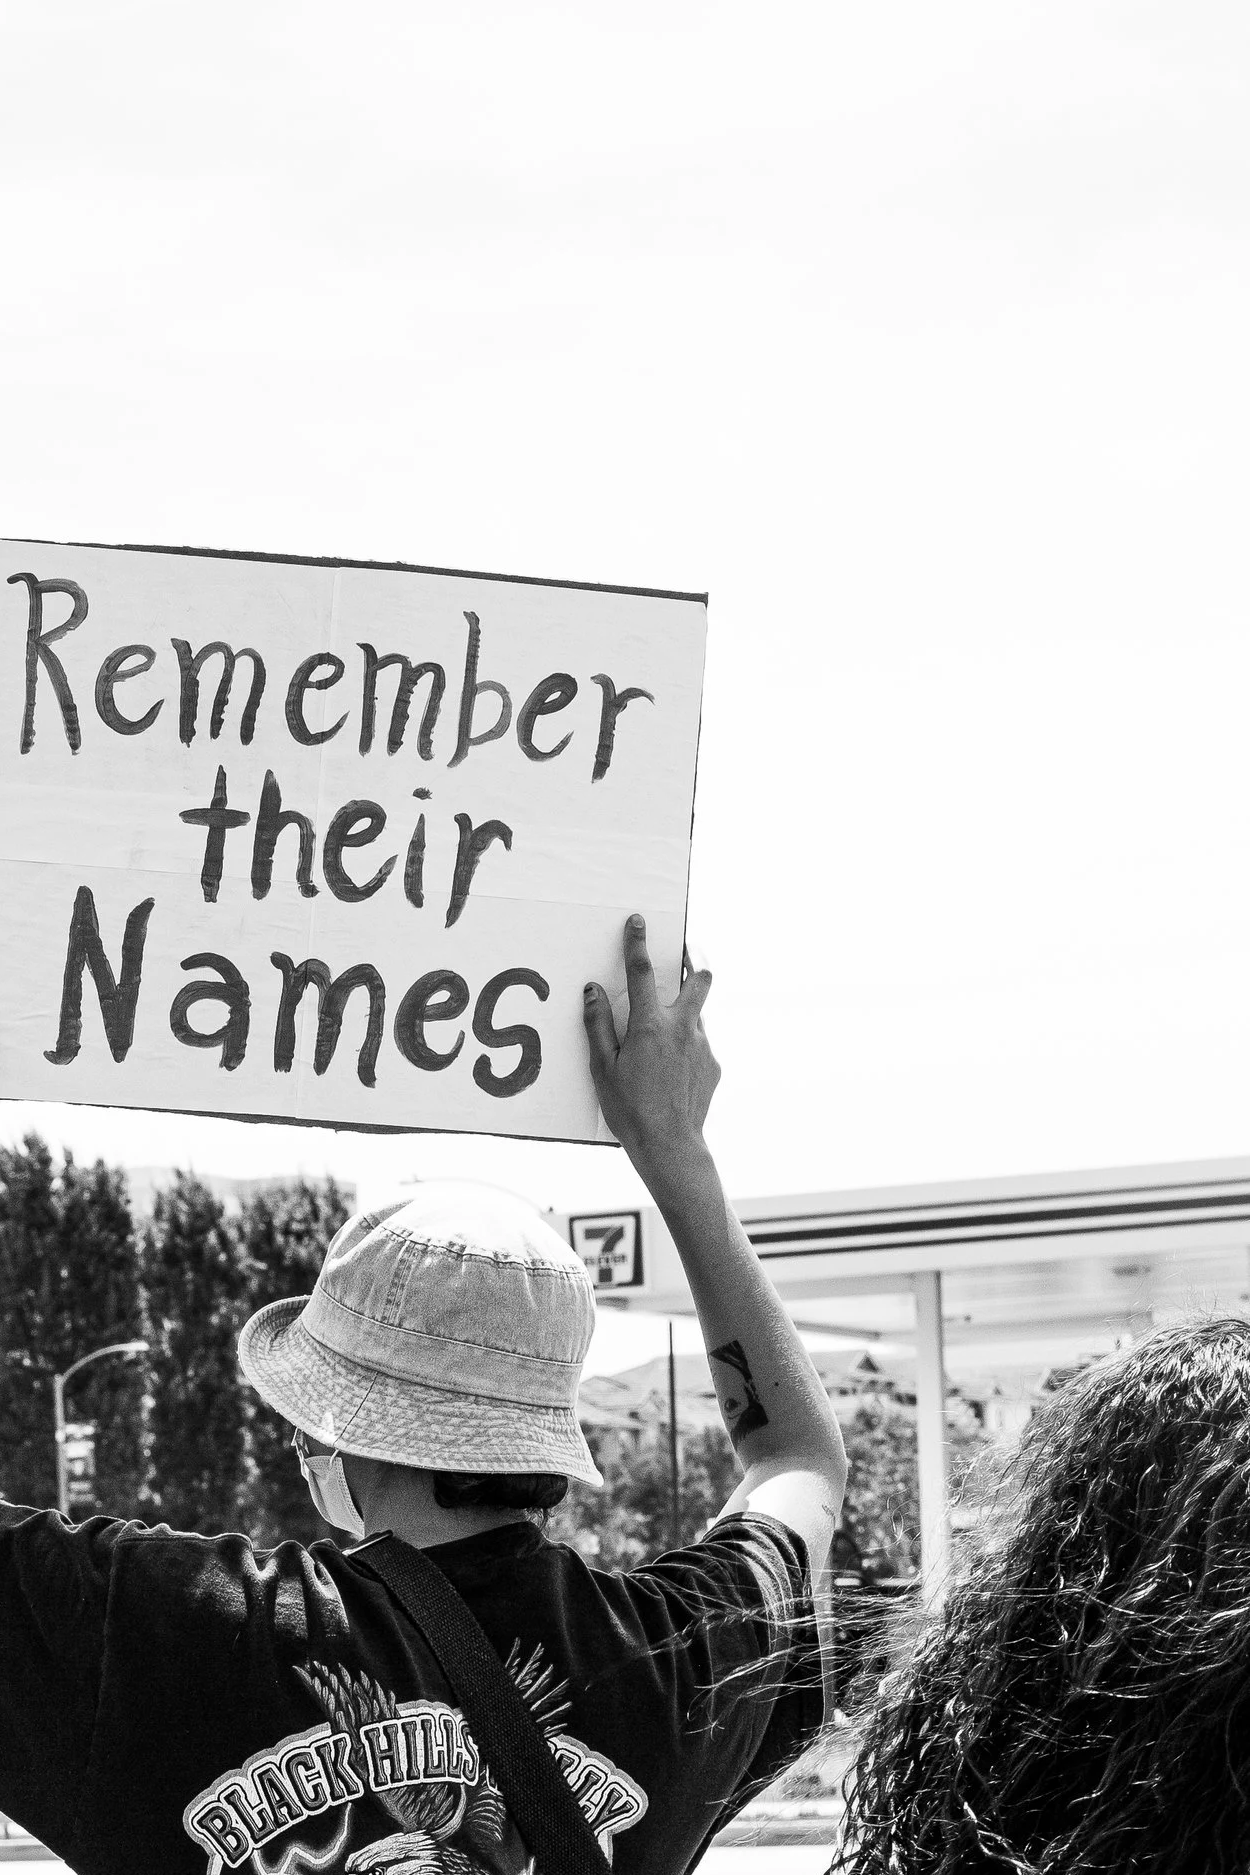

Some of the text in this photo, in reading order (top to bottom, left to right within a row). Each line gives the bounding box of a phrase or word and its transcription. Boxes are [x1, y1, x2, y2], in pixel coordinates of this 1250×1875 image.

[6, 571, 654, 783] Remember
[179, 764, 512, 928] their
[43, 885, 550, 1098] Names
[192, 1733, 363, 1866] BLACK
[360, 1713, 479, 1792] HILLS
